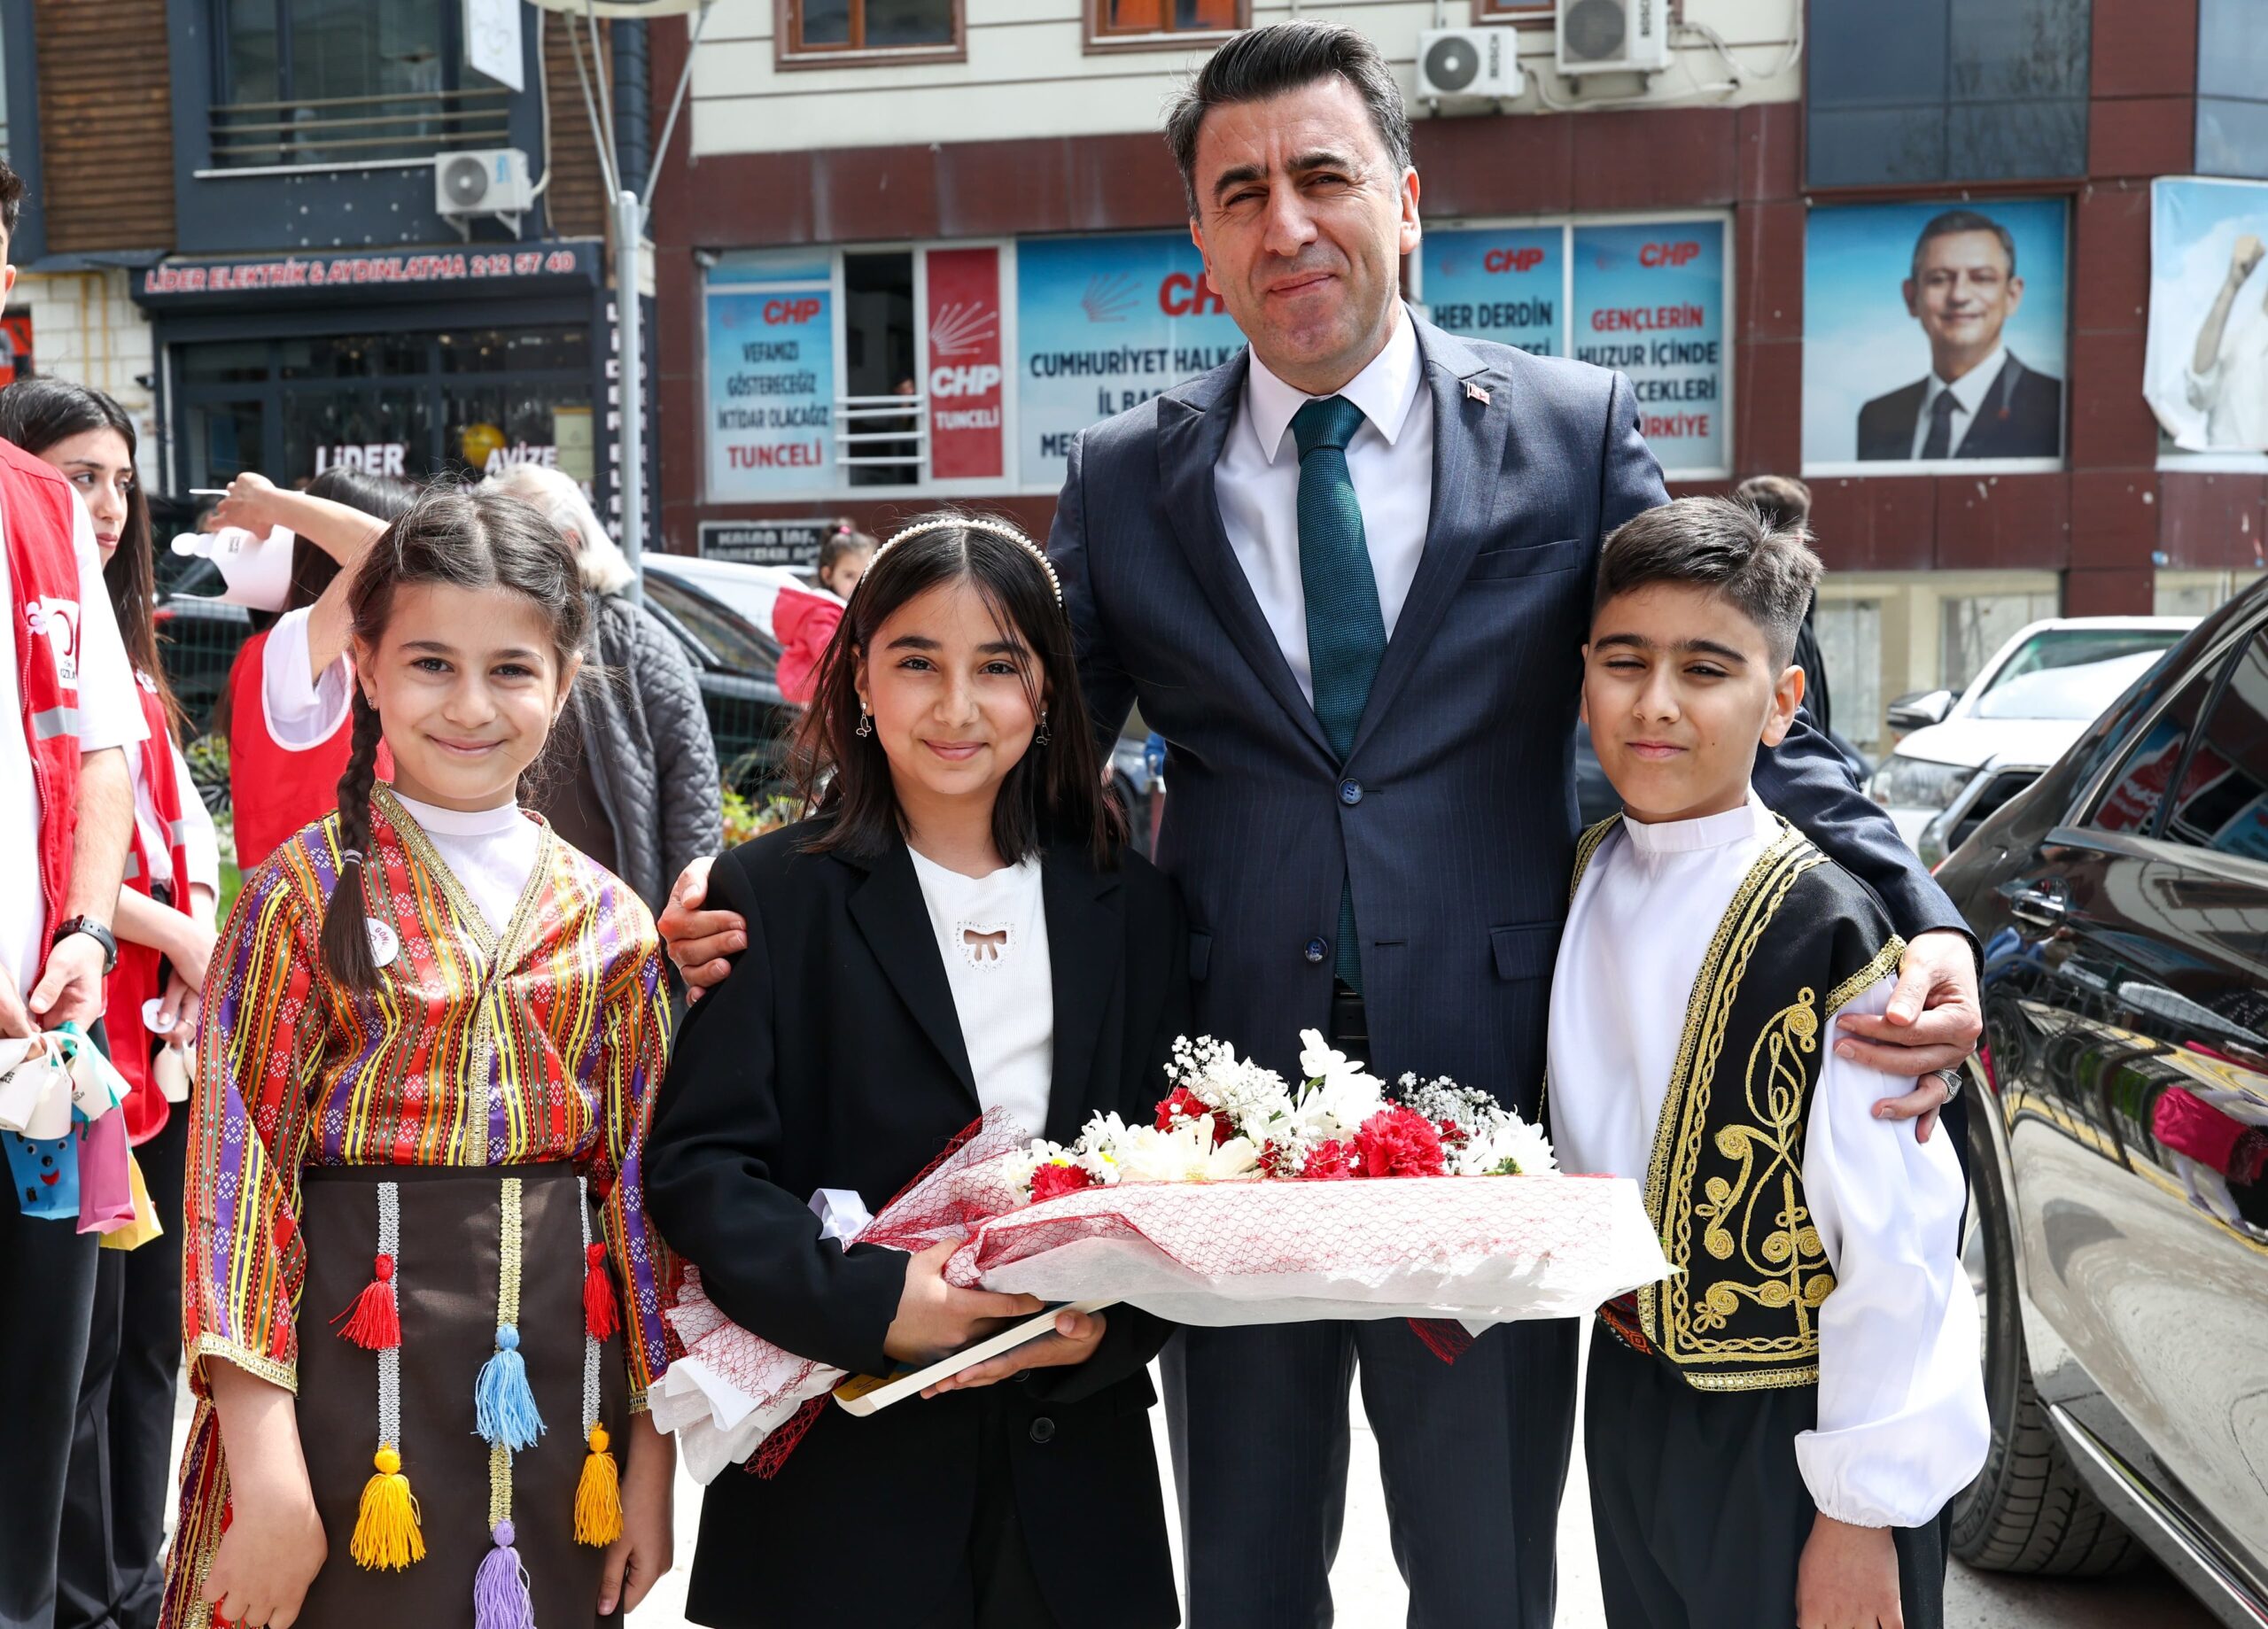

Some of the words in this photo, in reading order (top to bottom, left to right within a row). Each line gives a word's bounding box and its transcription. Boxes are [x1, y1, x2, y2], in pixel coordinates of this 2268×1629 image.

[309, 260, 325, 284] &
[326, 253, 467, 285] AYDINLATMA
[470, 253, 511, 277] 212
[1483, 248, 1545, 273] CHP
[1639, 241, 1701, 268] CHP
[1159, 272, 1229, 317] CH
[763, 298, 821, 326] CHP
[1433, 304, 1473, 330] HER
[1479, 295, 1553, 329] DERDİN
[1592, 300, 1704, 334] GENÇLERİN
[1029, 344, 1169, 378] CUMHURİYET
[1174, 346, 1230, 373] HALK
[1578, 345, 1645, 367] HUZUR
[1651, 338, 1718, 369] İÇİNDE
[930, 364, 1001, 398] CHP
[1098, 386, 1118, 415] İL
[936, 405, 999, 431] TUNCELİ
[1639, 409, 1710, 438] ÜRKİYE
[727, 438, 823, 469] TUNCELİ
